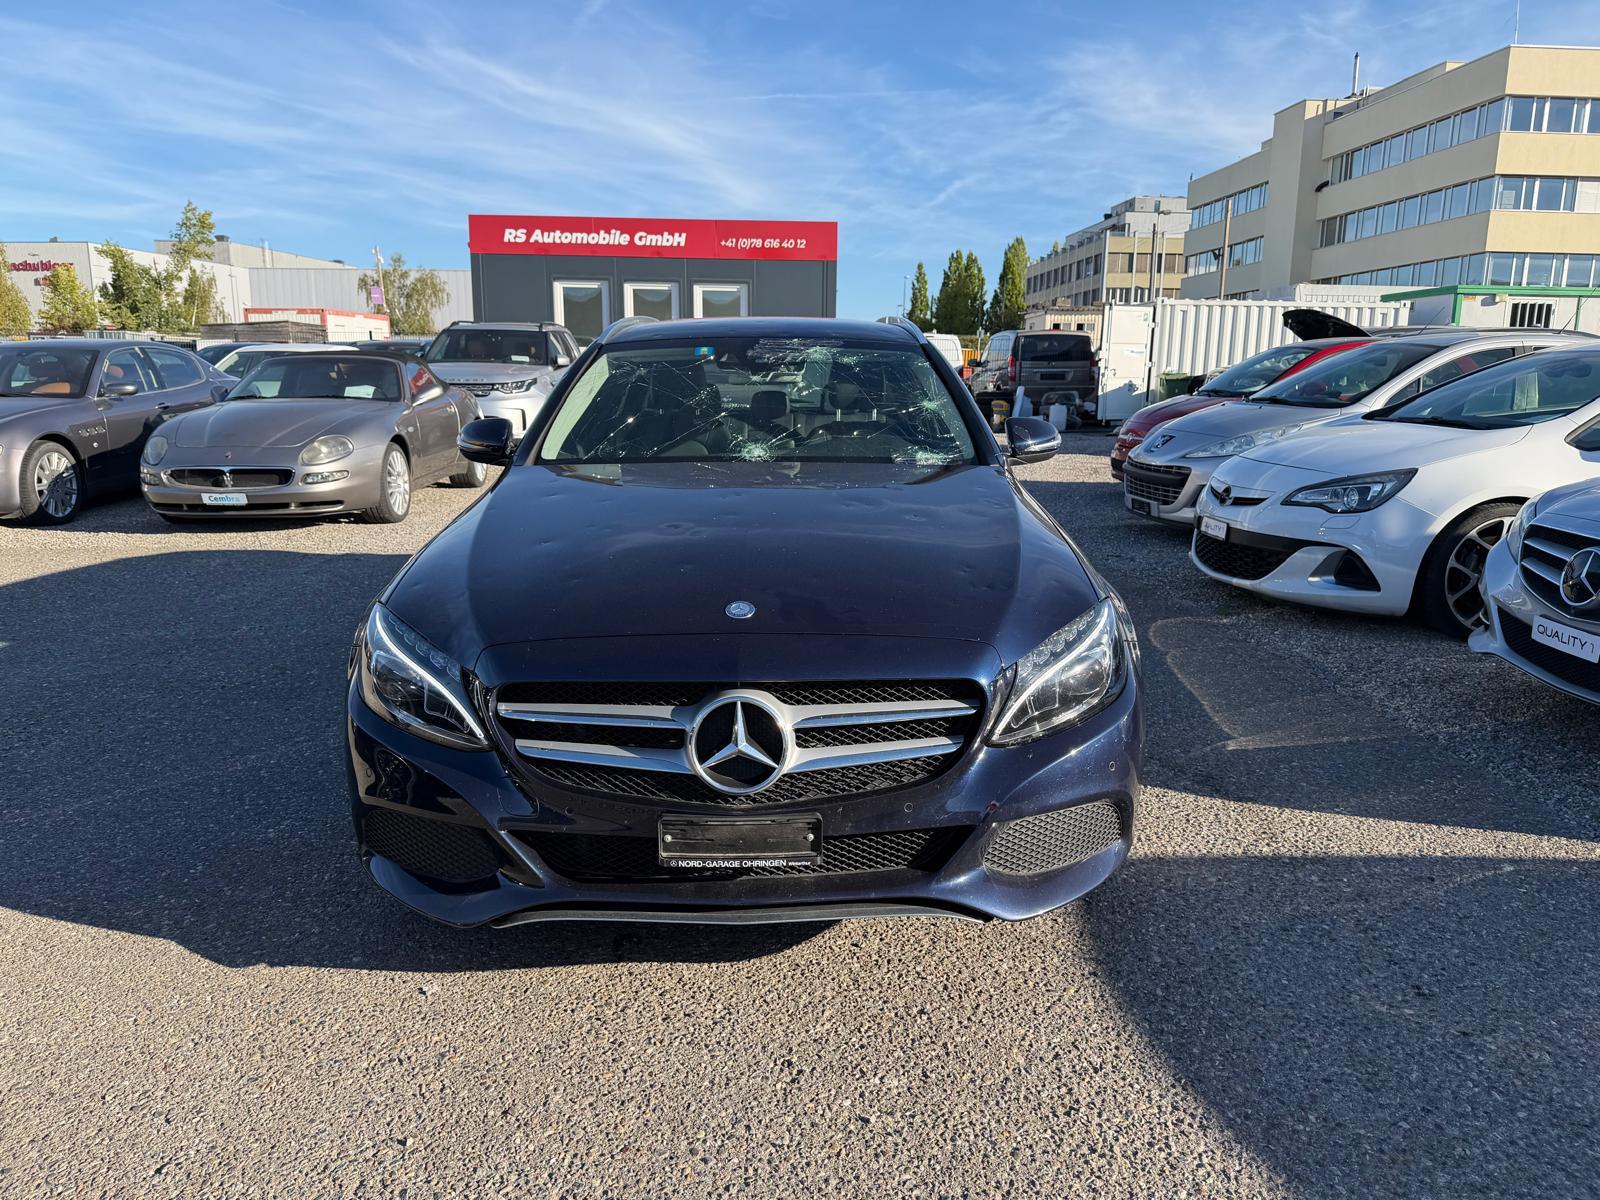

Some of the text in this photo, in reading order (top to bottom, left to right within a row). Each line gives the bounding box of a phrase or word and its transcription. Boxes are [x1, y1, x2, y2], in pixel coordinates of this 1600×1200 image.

[503, 228, 687, 247] RS Automobile GmbH
[720, 238, 806, 250] +41 (0)78 616 40 12
[1536, 624, 1595, 654] QUALITY 1
[678, 860, 741, 868] NORD-GARAGE
[742, 859, 787, 868] OHRINGEN
